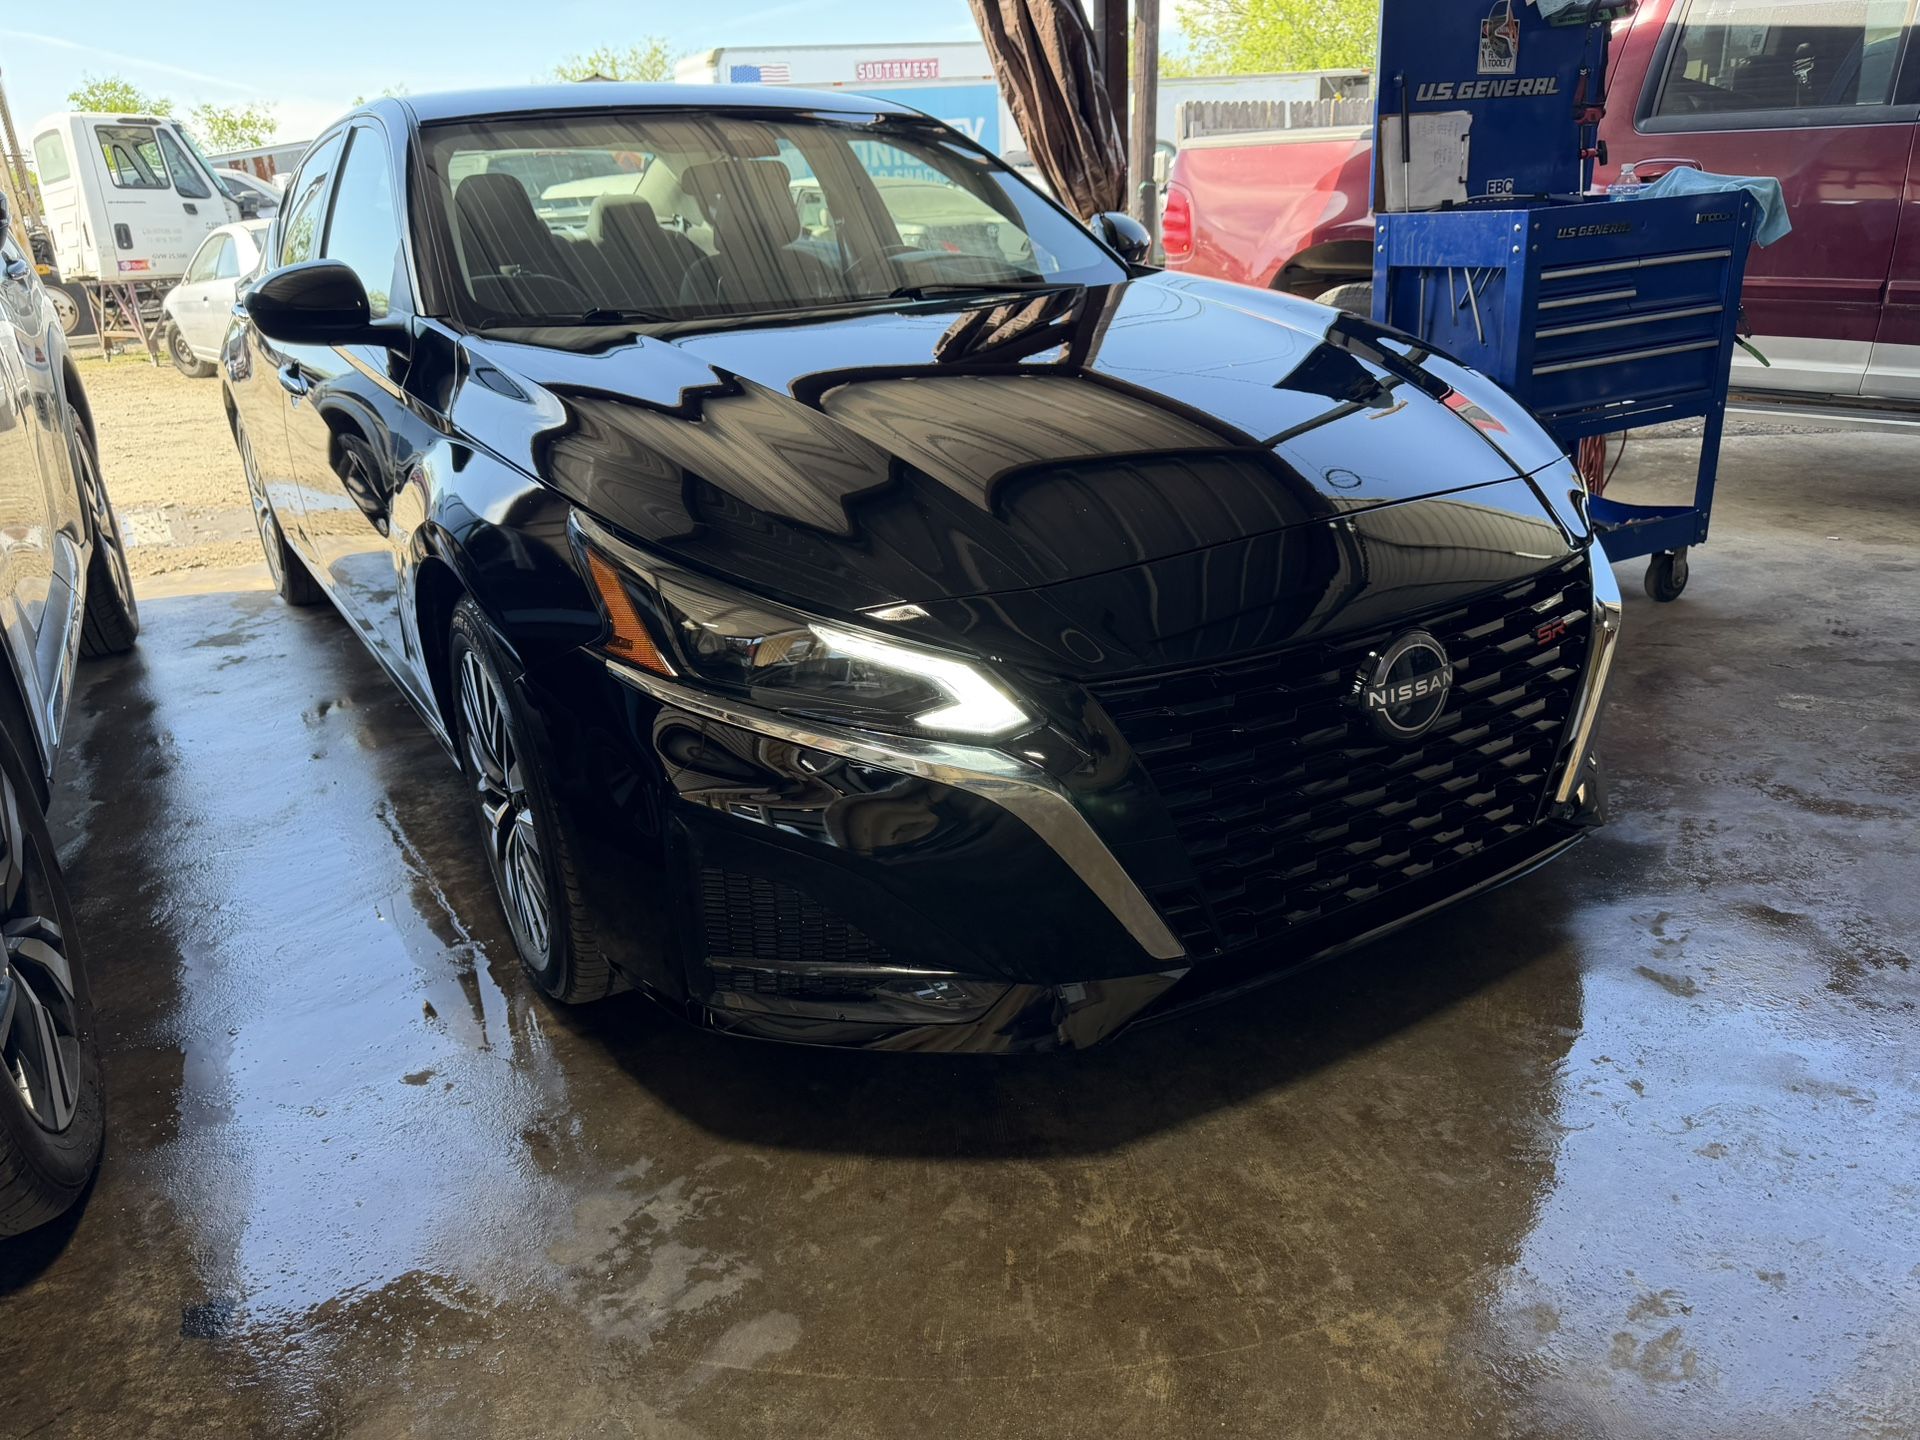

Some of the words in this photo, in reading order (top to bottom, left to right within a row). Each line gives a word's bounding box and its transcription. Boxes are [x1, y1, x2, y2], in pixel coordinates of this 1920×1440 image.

[857, 60, 938, 80] SOUTHWEST
[1488, 59, 1507, 68] TOOLS
[1455, 77, 1561, 99] GENERAL
[1487, 179, 1513, 194] EBC
[1536, 618, 1566, 645] SR
[1368, 666, 1454, 707] NISSAN
